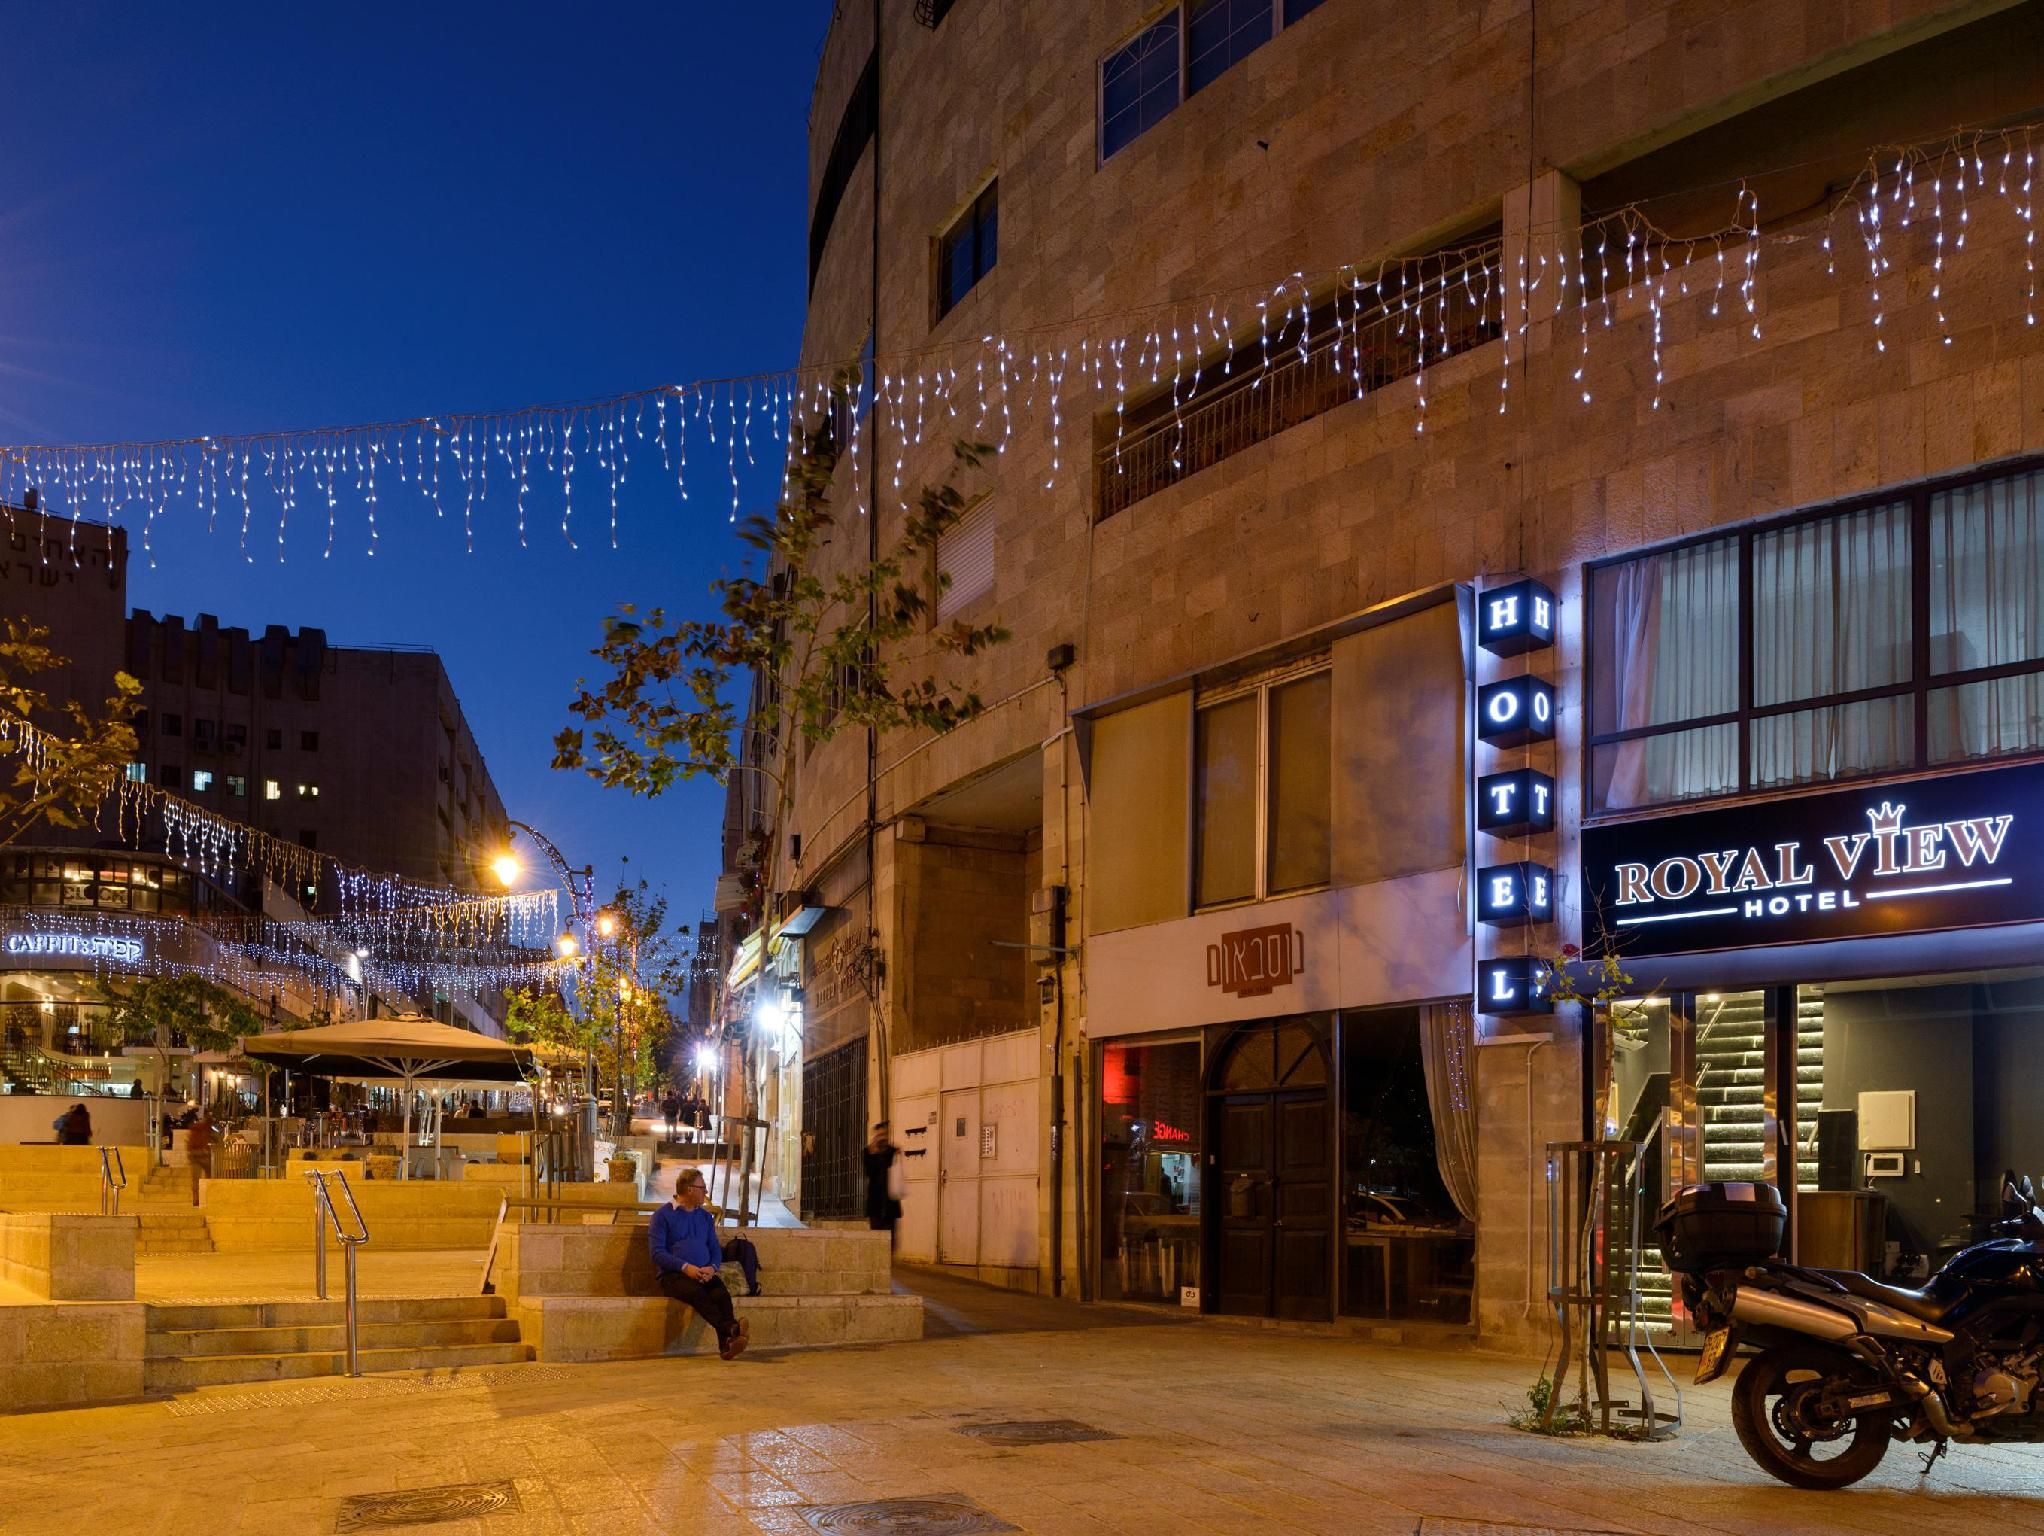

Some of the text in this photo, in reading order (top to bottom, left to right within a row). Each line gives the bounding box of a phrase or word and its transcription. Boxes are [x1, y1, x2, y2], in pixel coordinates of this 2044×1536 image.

[1489, 596, 1518, 1000] HOTEL
[1615, 814, 2013, 905] ROYAL VIEW
[1744, 889, 1860, 918] HOTEL
[92, 938, 142, 961] קפית
[1207, 929, 1305, 987] נוסבאום
